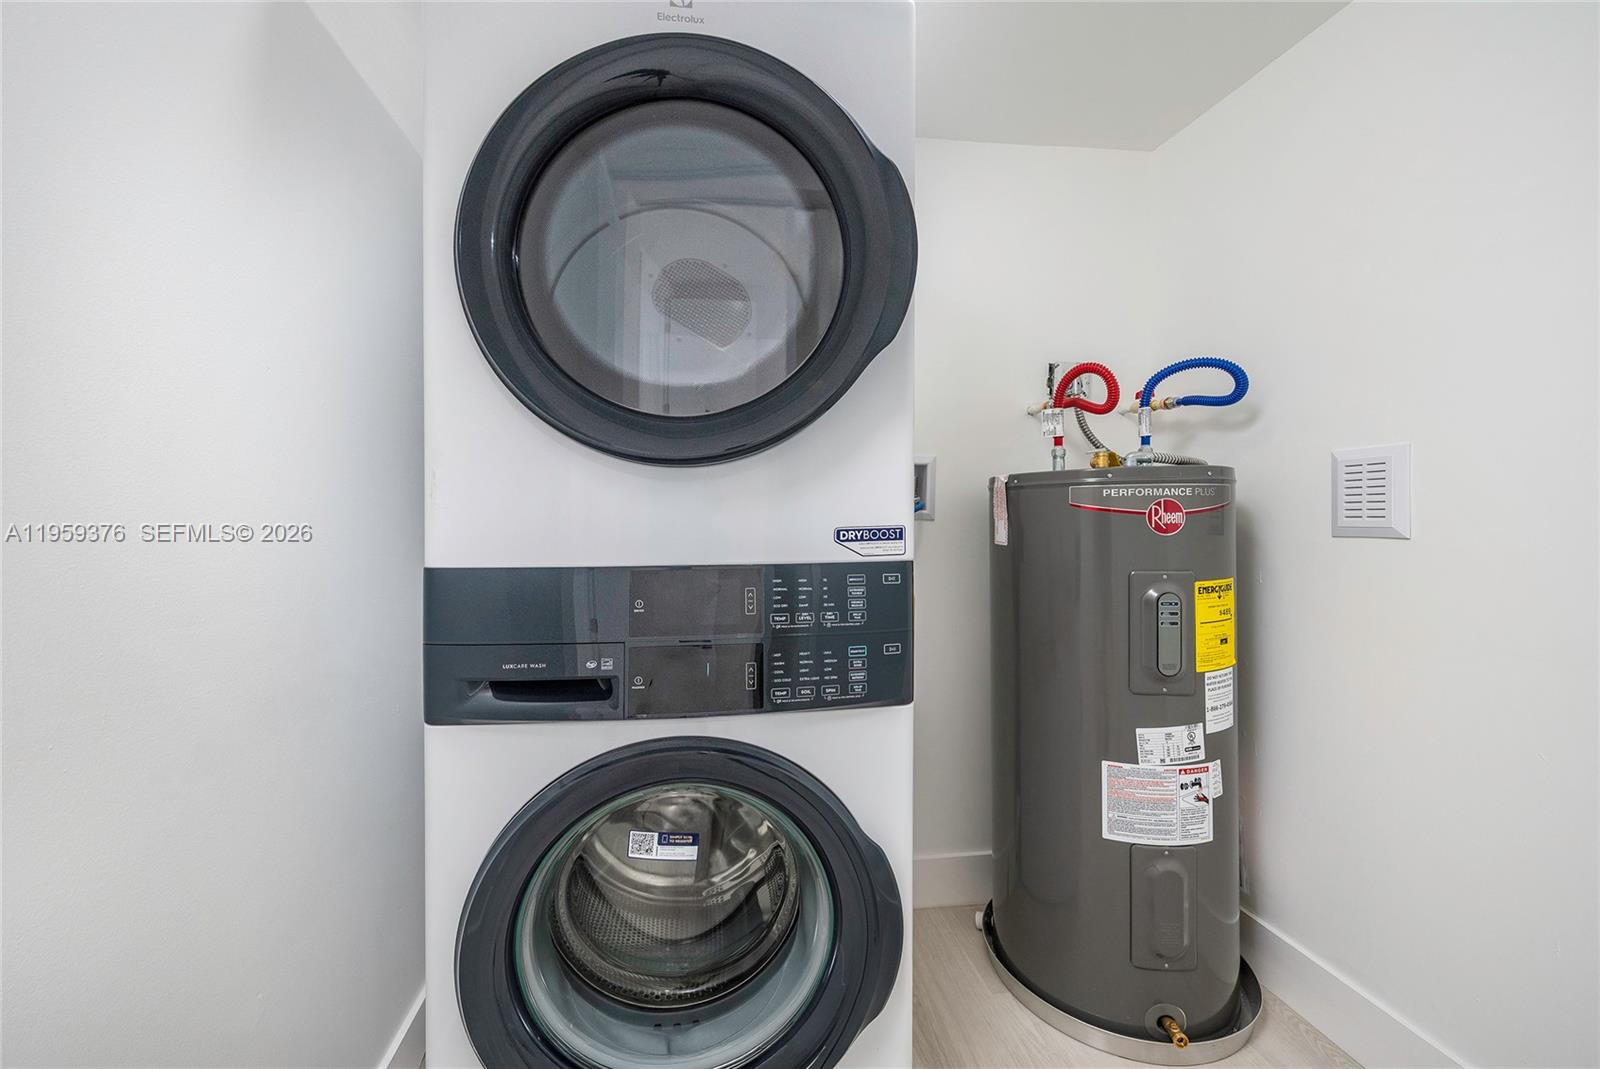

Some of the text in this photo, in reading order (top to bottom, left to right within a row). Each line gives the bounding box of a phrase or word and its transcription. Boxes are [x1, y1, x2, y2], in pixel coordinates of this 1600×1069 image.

[657, 12, 705, 24] Electrolux
[1103, 488, 1215, 497] PERFORMANCE PLUS
[1152, 499, 1183, 529] Rheem
[841, 529, 901, 540] DRYBOOST
